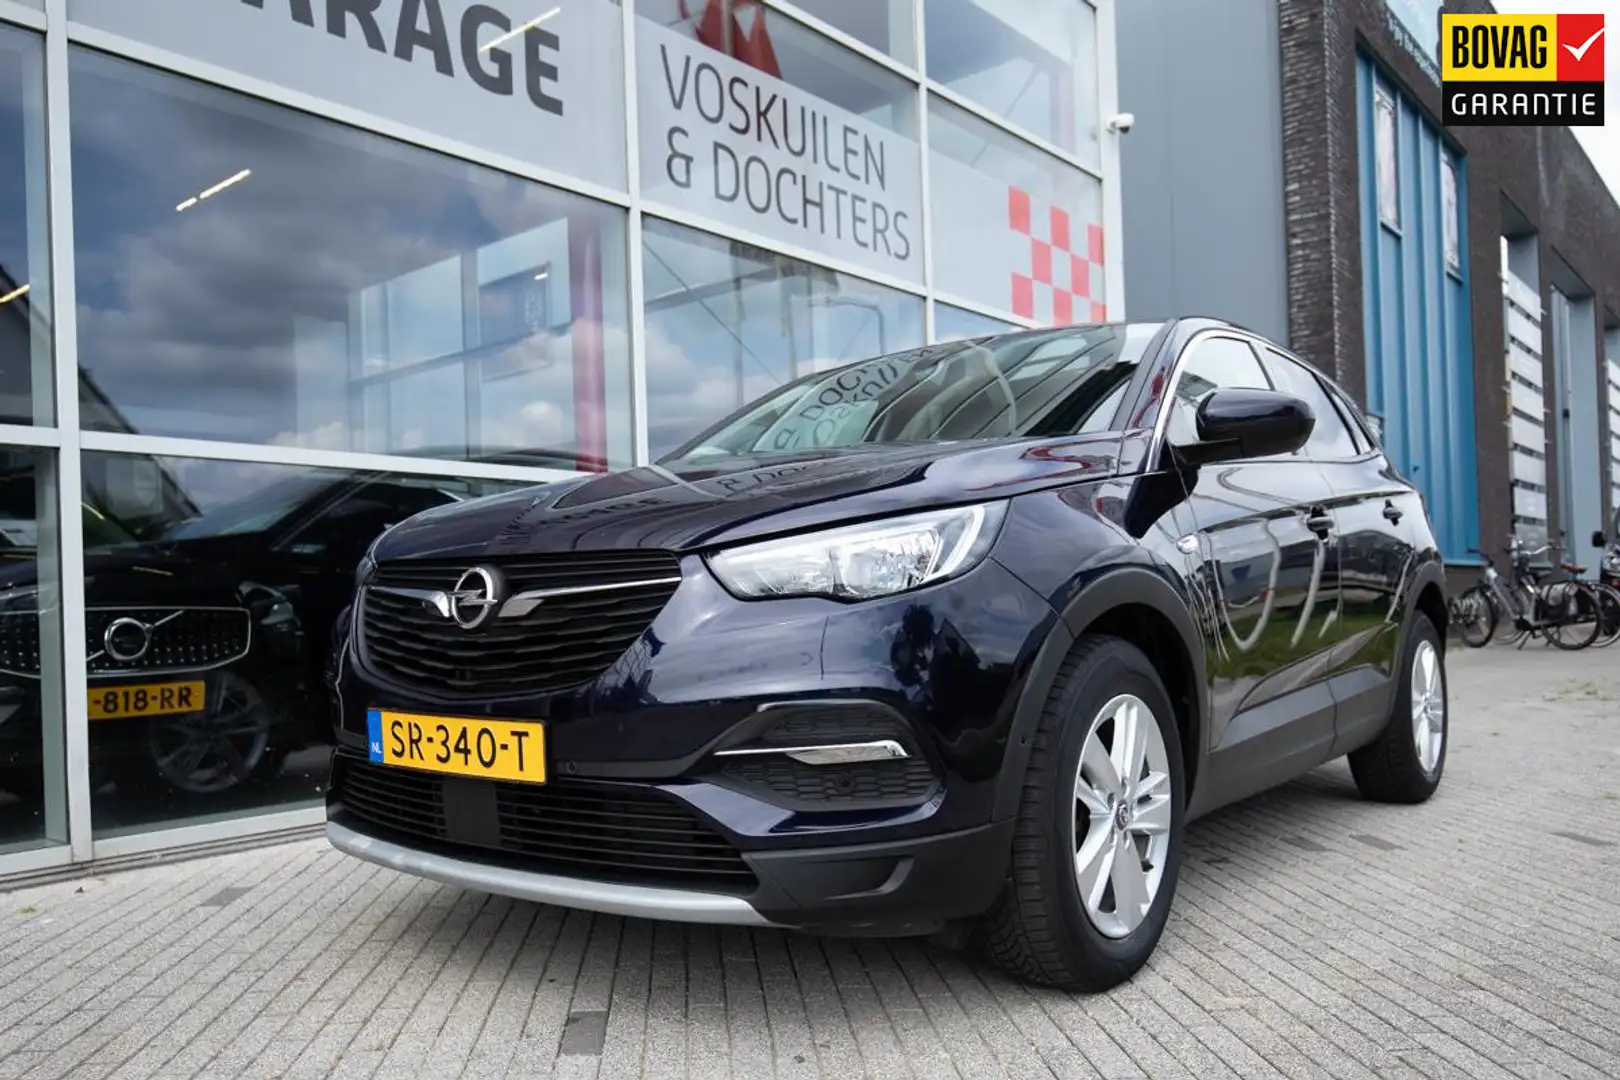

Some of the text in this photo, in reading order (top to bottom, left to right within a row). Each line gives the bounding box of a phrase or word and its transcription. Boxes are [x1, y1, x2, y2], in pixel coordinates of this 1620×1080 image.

[660, 43, 886, 191] VOSKUILEN
[666, 126, 910, 261] & DOCHTERS
[371, 741, 382, 754] NL
[391, 719, 530, 772] SR-340-T
